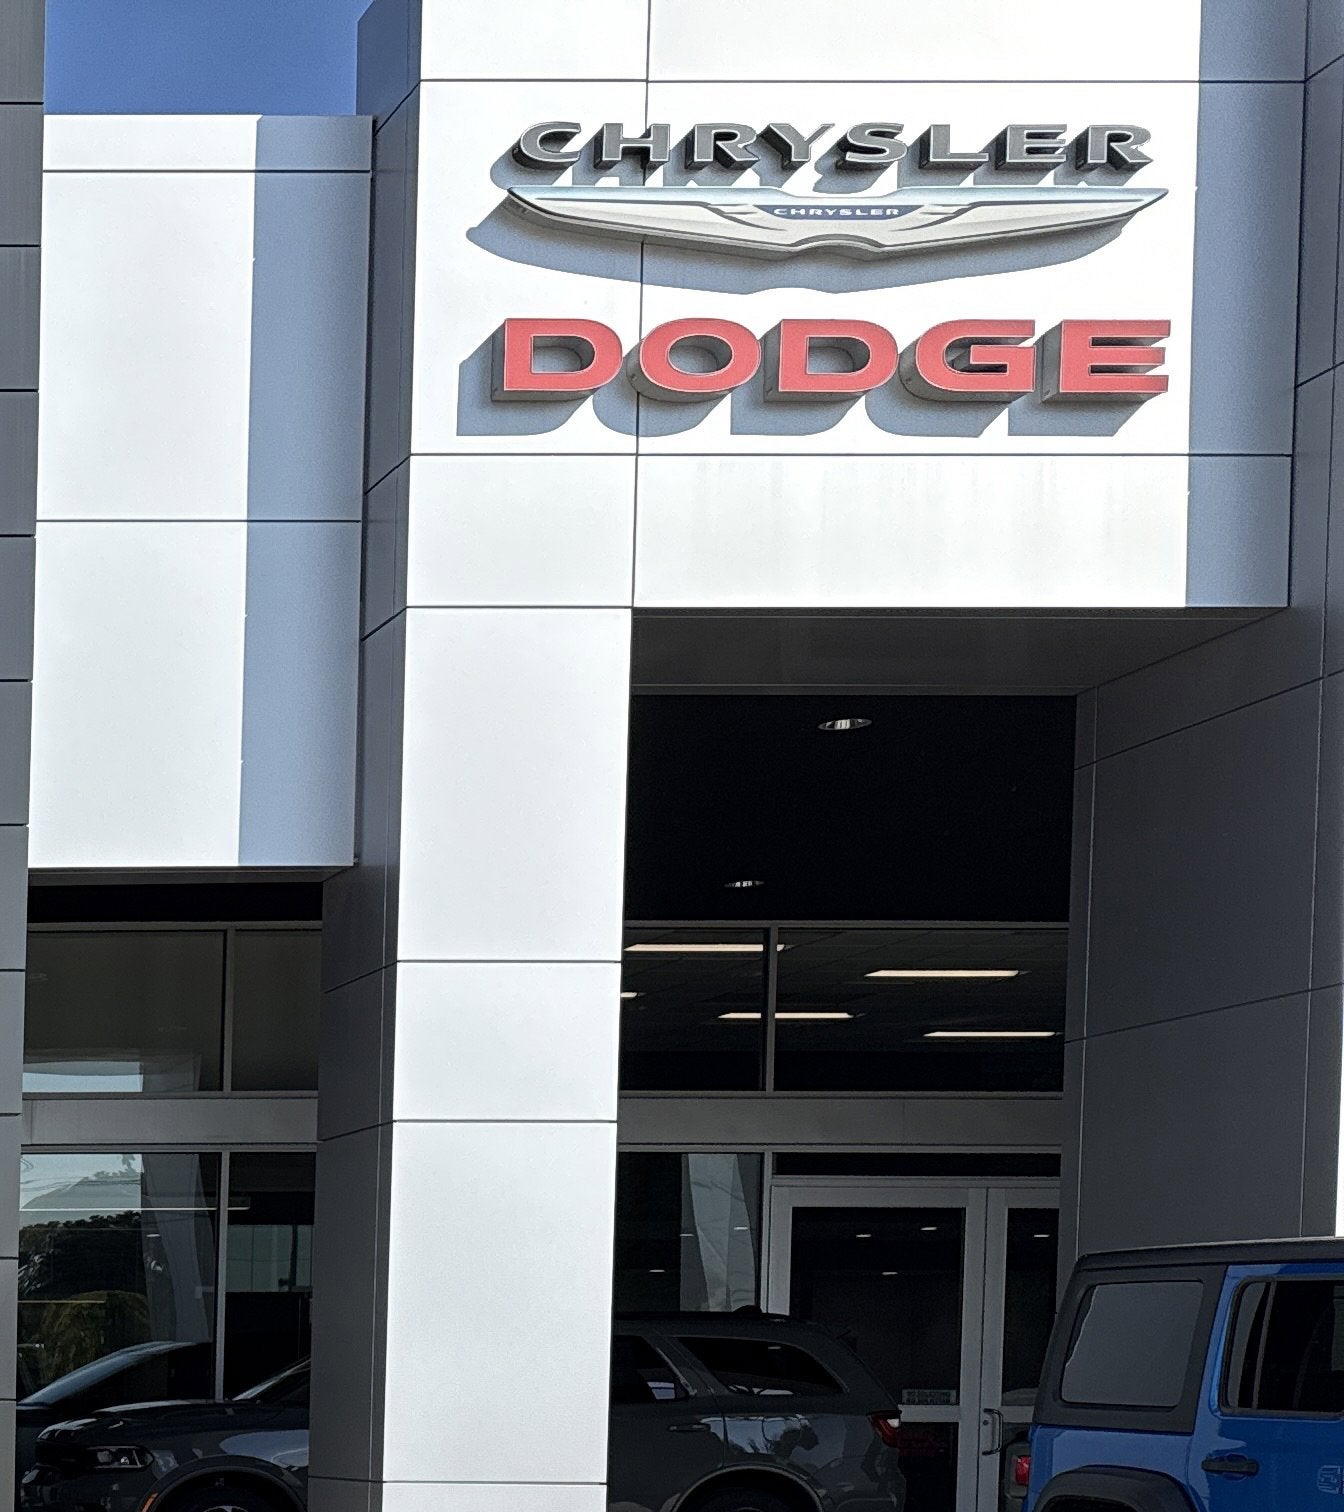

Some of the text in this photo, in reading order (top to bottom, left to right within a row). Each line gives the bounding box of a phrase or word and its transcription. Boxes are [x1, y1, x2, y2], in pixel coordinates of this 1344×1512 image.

[516, 121, 1153, 170] CHRYSLER
[774, 208, 899, 216] CHRYSLER
[498, 318, 1171, 396] DODGE
